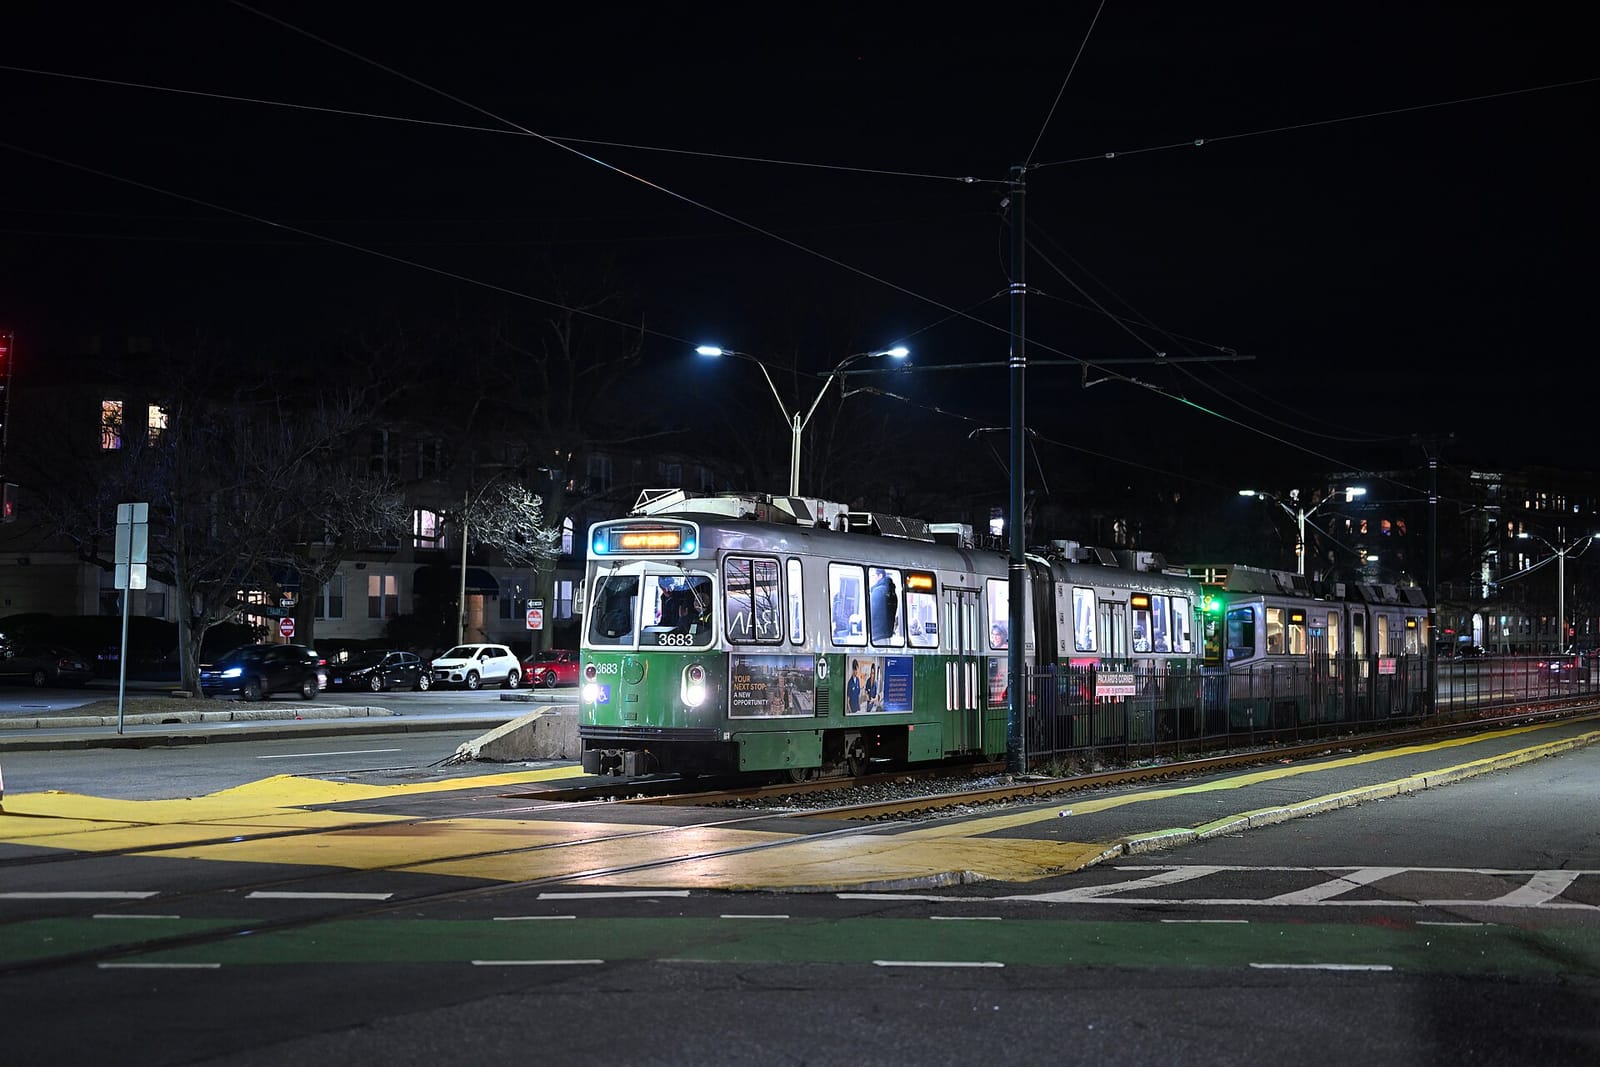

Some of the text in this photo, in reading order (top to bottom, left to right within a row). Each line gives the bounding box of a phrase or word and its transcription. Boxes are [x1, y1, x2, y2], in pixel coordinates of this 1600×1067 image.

[658, 633, 694, 646] 3683
[596, 663, 618, 674] 3683
[734, 675, 751, 683] YOUR
[733, 683, 749, 691] NEXT
